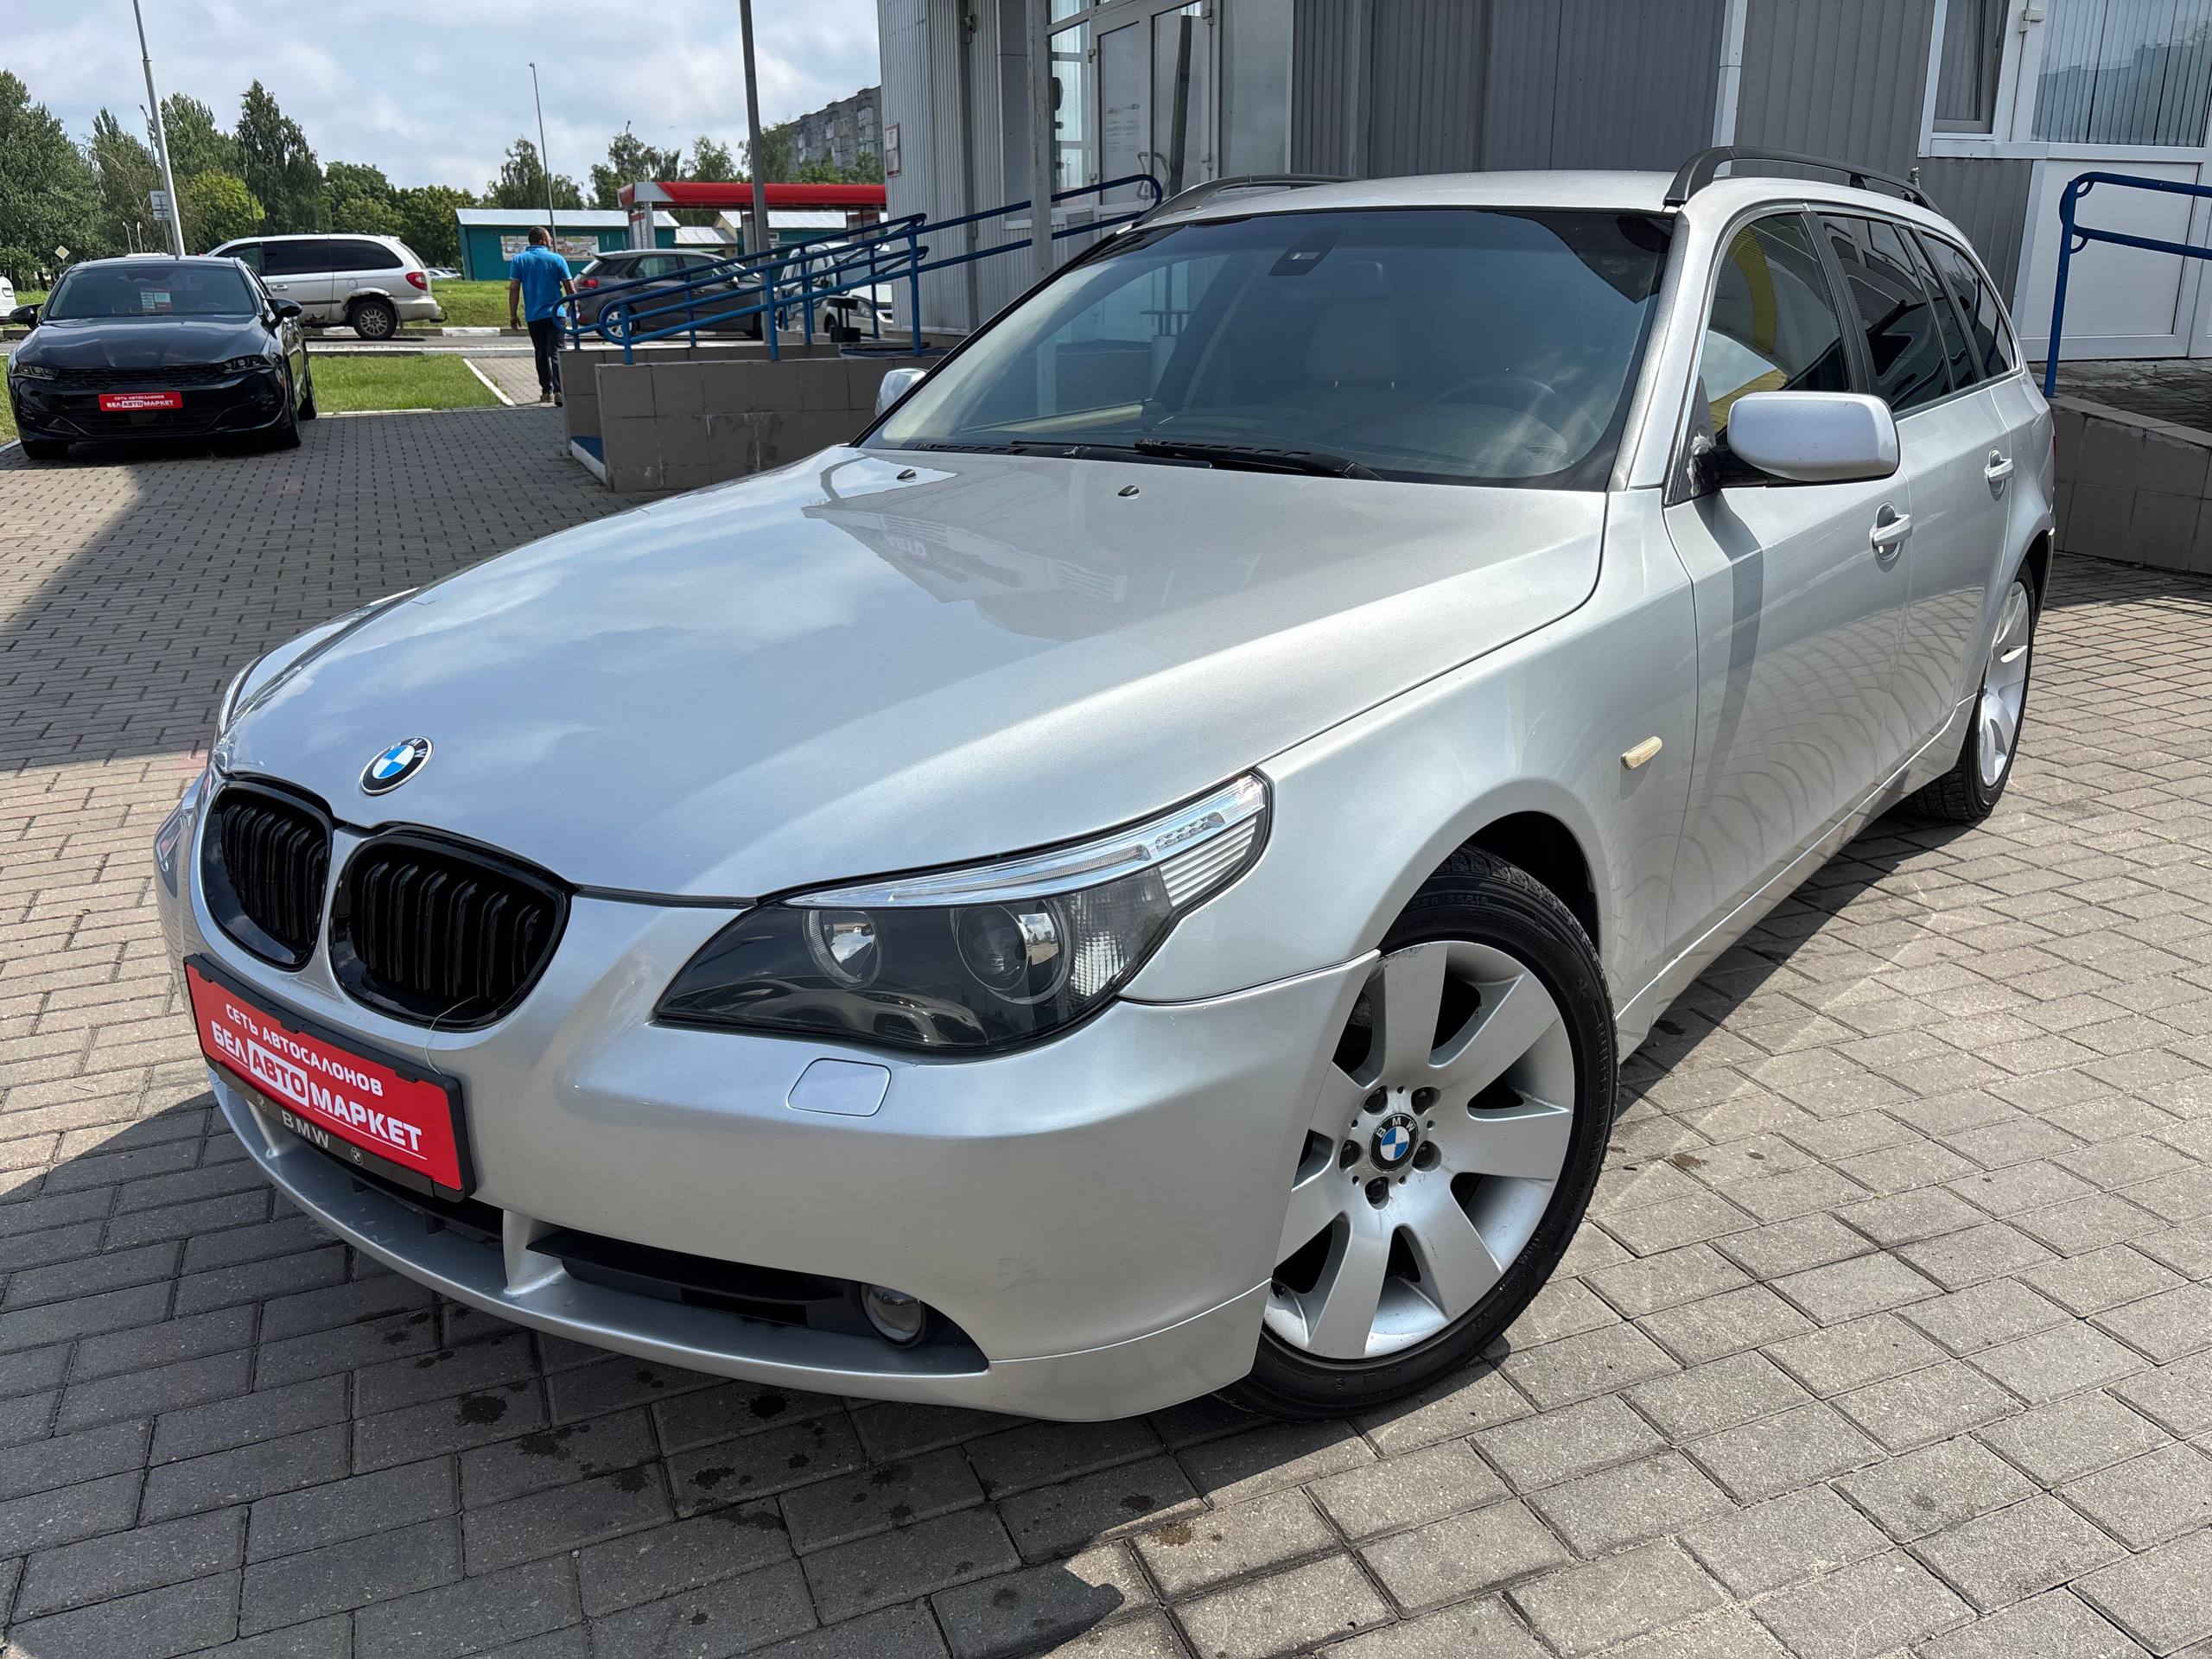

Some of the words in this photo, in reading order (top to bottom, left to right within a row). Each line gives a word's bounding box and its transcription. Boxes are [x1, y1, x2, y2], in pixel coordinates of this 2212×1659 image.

[226, 1003, 258, 1036] СЕТЬ
[263, 1027, 384, 1096] АВТОСАЛОНОВ
[282, 1109, 329, 1148] BMW
[1376, 1116, 1416, 1138] BMW
